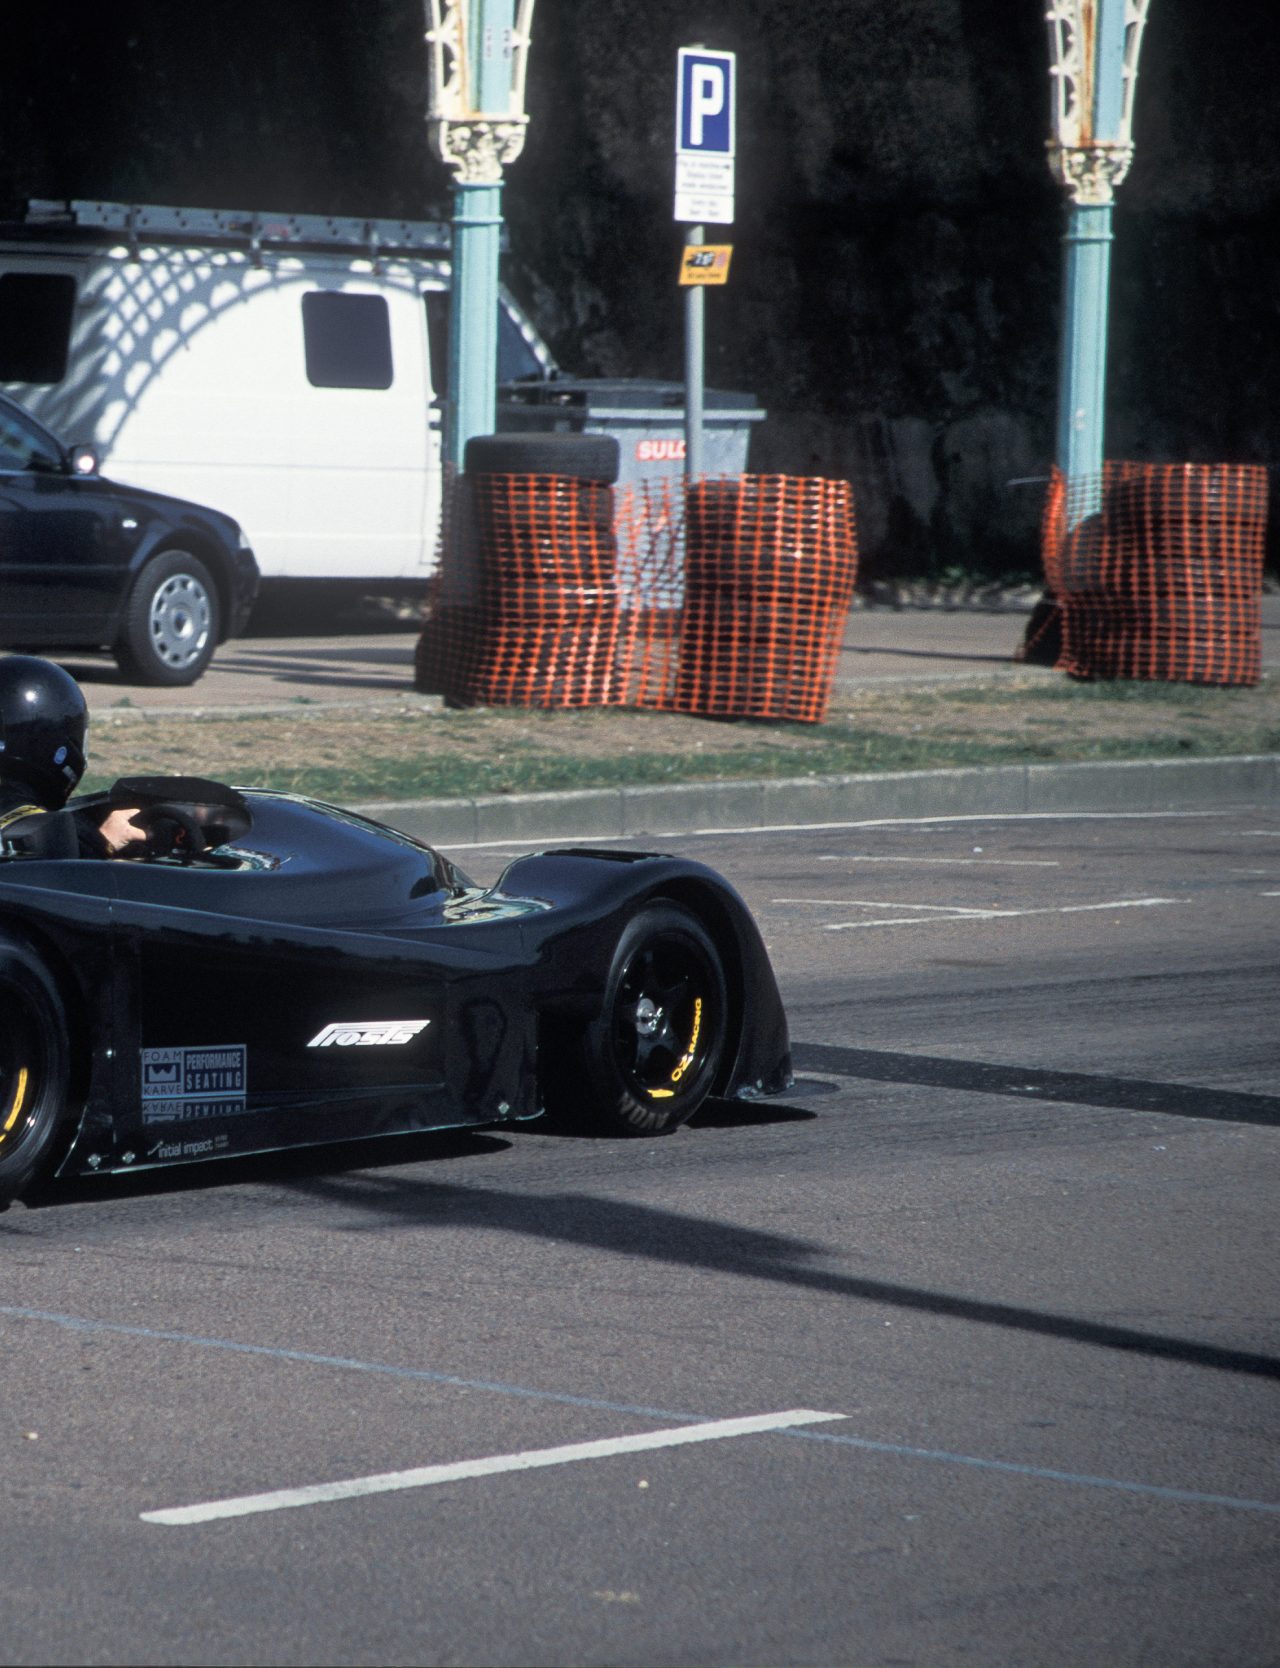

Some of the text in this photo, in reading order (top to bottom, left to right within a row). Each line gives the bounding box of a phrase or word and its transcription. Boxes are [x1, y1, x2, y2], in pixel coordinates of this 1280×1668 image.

[690, 63, 724, 145] P
[688, 997, 702, 1053] RACING
[144, 1052, 182, 1062] FOAM
[187, 1053, 241, 1070] PERFORMANCE
[187, 1071, 241, 1090] SEATING
[144, 1084, 182, 1095] KARVE
[184, 1139, 214, 1156] impact
